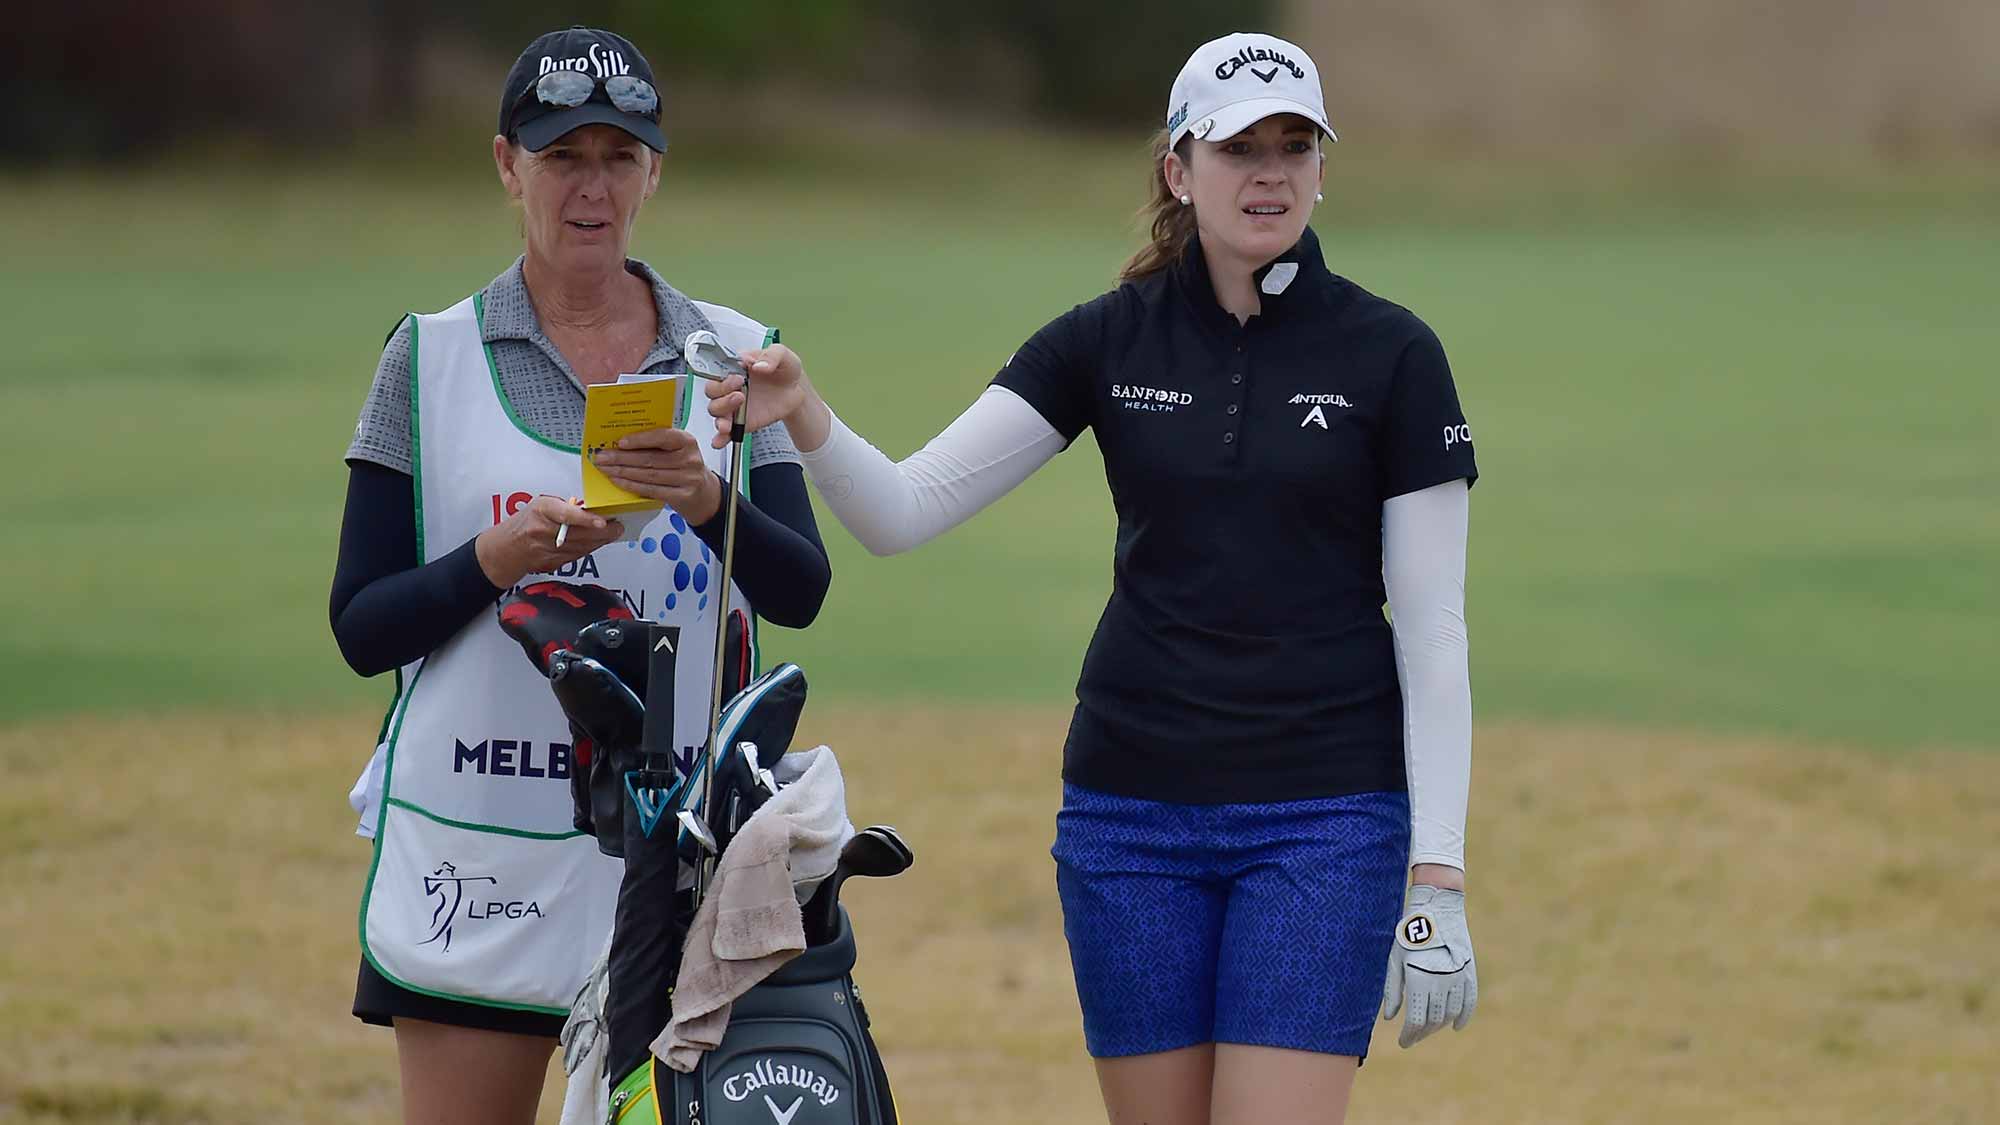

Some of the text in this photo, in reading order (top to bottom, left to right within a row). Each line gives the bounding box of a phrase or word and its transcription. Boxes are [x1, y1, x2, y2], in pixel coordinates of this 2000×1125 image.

[589, 43, 631, 78] Silk
[1215, 46, 1305, 80] Callaway
[1111, 384, 1193, 405] SANFORD
[1287, 393, 1349, 407] ANTIGUA
[1124, 401, 1174, 412] HEALTH
[468, 900, 541, 919] LPGA
[1407, 917, 1429, 943] FJ
[723, 1058, 839, 1106] Callaway
